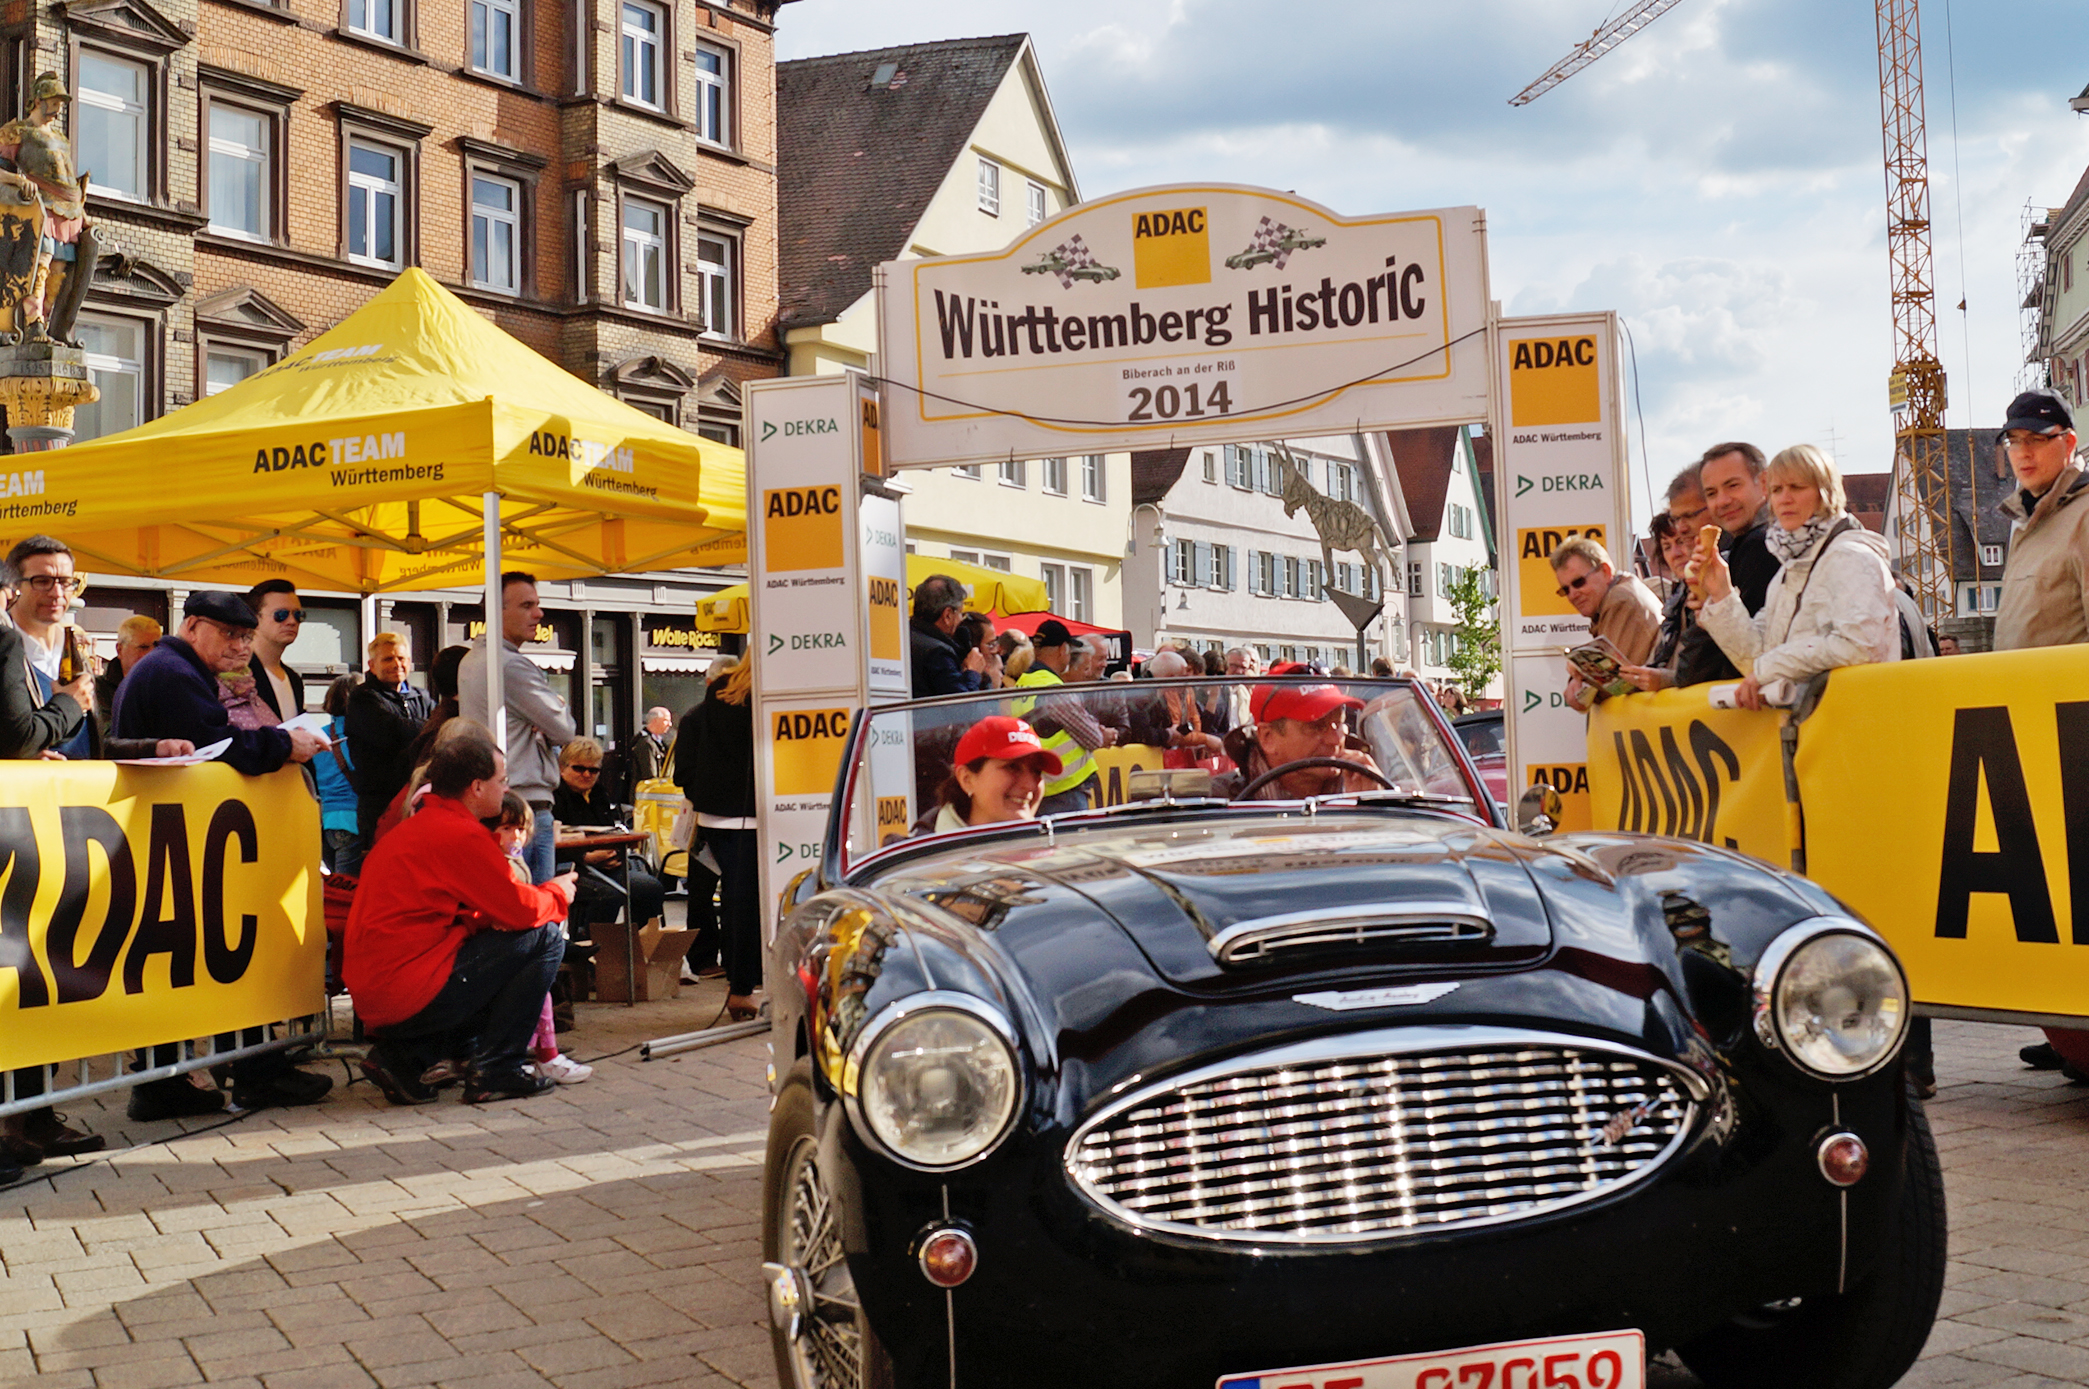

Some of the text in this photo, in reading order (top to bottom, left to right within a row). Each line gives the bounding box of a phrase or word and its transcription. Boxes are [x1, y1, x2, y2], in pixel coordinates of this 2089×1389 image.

[1135, 209, 1205, 239] ADAC
[934, 255, 1426, 360] Württemberg Historic
[1513, 338, 1594, 370] ADAC
[1122, 360, 1236, 380] Biberach an der Riß
[1127, 380, 1233, 421] 2014
[784, 418, 839, 436] DEKRA
[1513, 431, 1602, 444] ADAC Württemberg
[331, 462, 444, 486] Württemberg
[584, 472, 659, 499] Württemberg
[1542, 473, 1604, 492] DEKRA
[768, 488, 839, 518] ADAC
[875, 529, 898, 548] DEKRA
[1522, 528, 1602, 559] AD
[869, 578, 899, 608] ADAC
[791, 633, 846, 650] DEKRA
[1522, 623, 1590, 634] ADAC Württem
[776, 711, 847, 741] ADAC
[881, 729, 905, 746] DEKRA
[1534, 767, 1591, 795] ADA
[1614, 719, 1740, 851] ADAC
[878, 799, 907, 827] ADAC
[801, 843, 821, 859] DE
[0, 799, 258, 1009] ADAC
